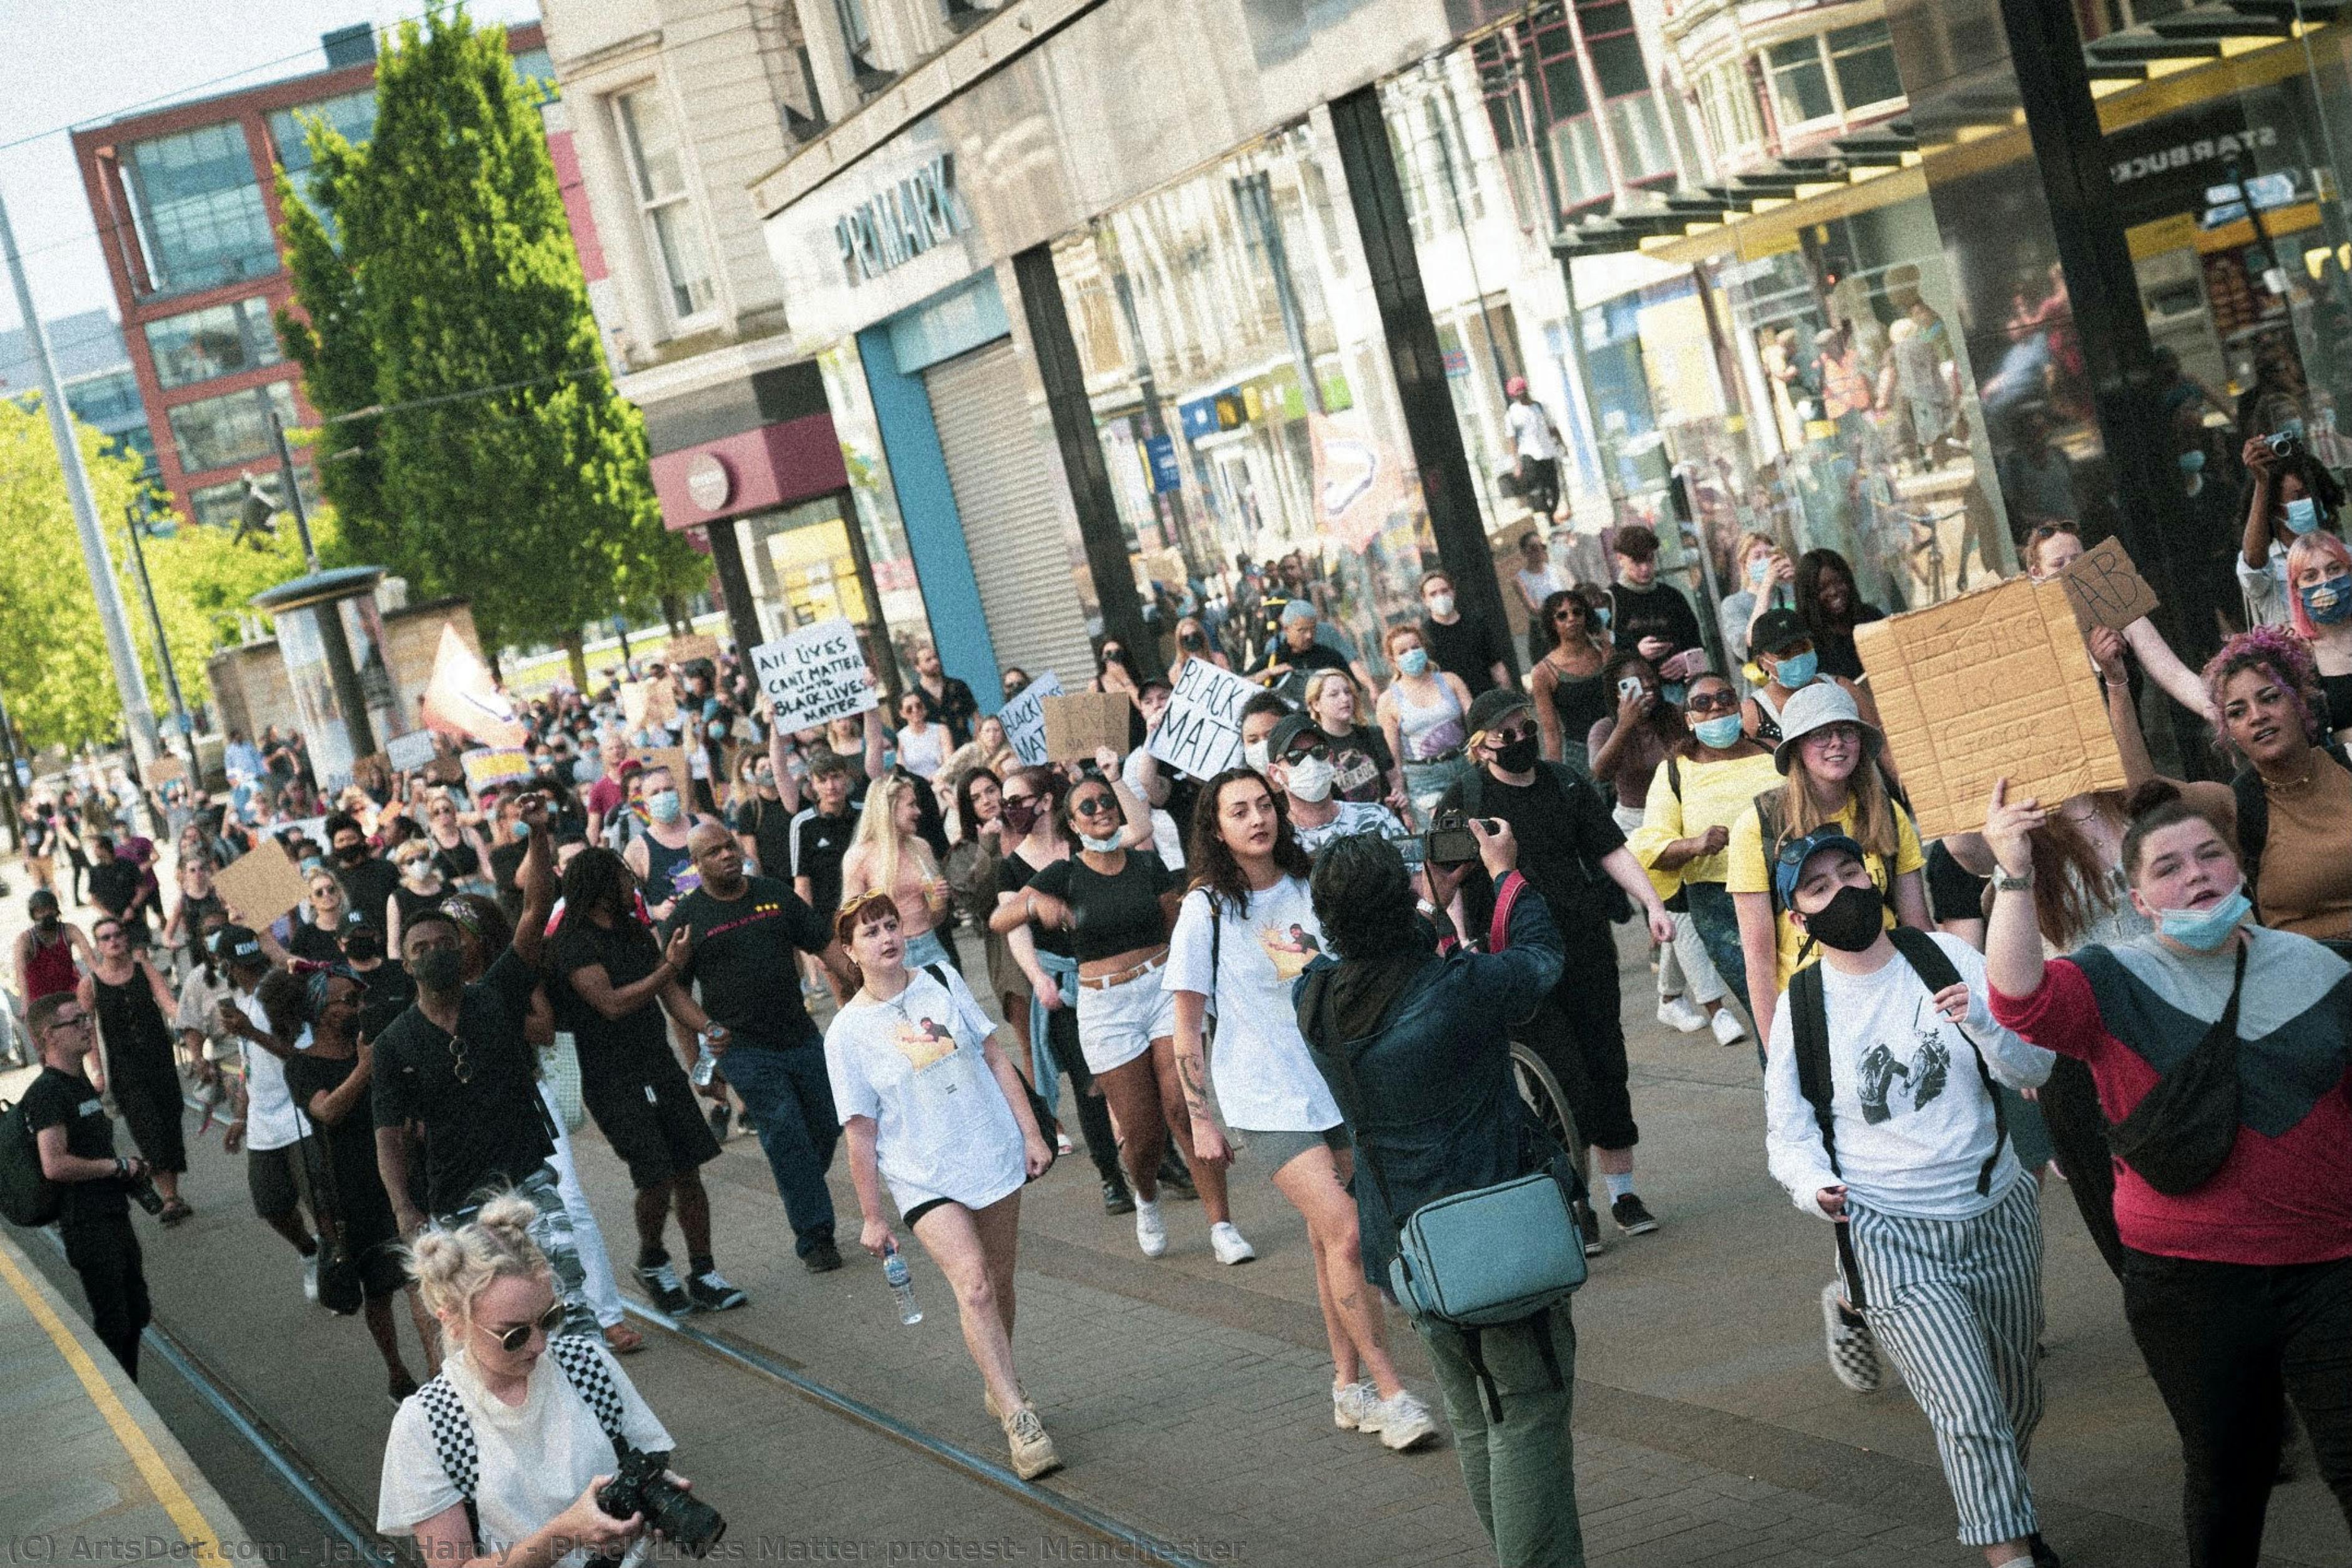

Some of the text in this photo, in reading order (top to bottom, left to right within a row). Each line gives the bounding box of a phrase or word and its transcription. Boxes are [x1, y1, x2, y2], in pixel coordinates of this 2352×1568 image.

[835, 153, 967, 286] PRIMARK
[809, 655, 862, 681] MATTER
[1174, 658, 1244, 721] BLACK
[774, 691, 824, 718] BLACK
[803, 697, 861, 722] MATTER
